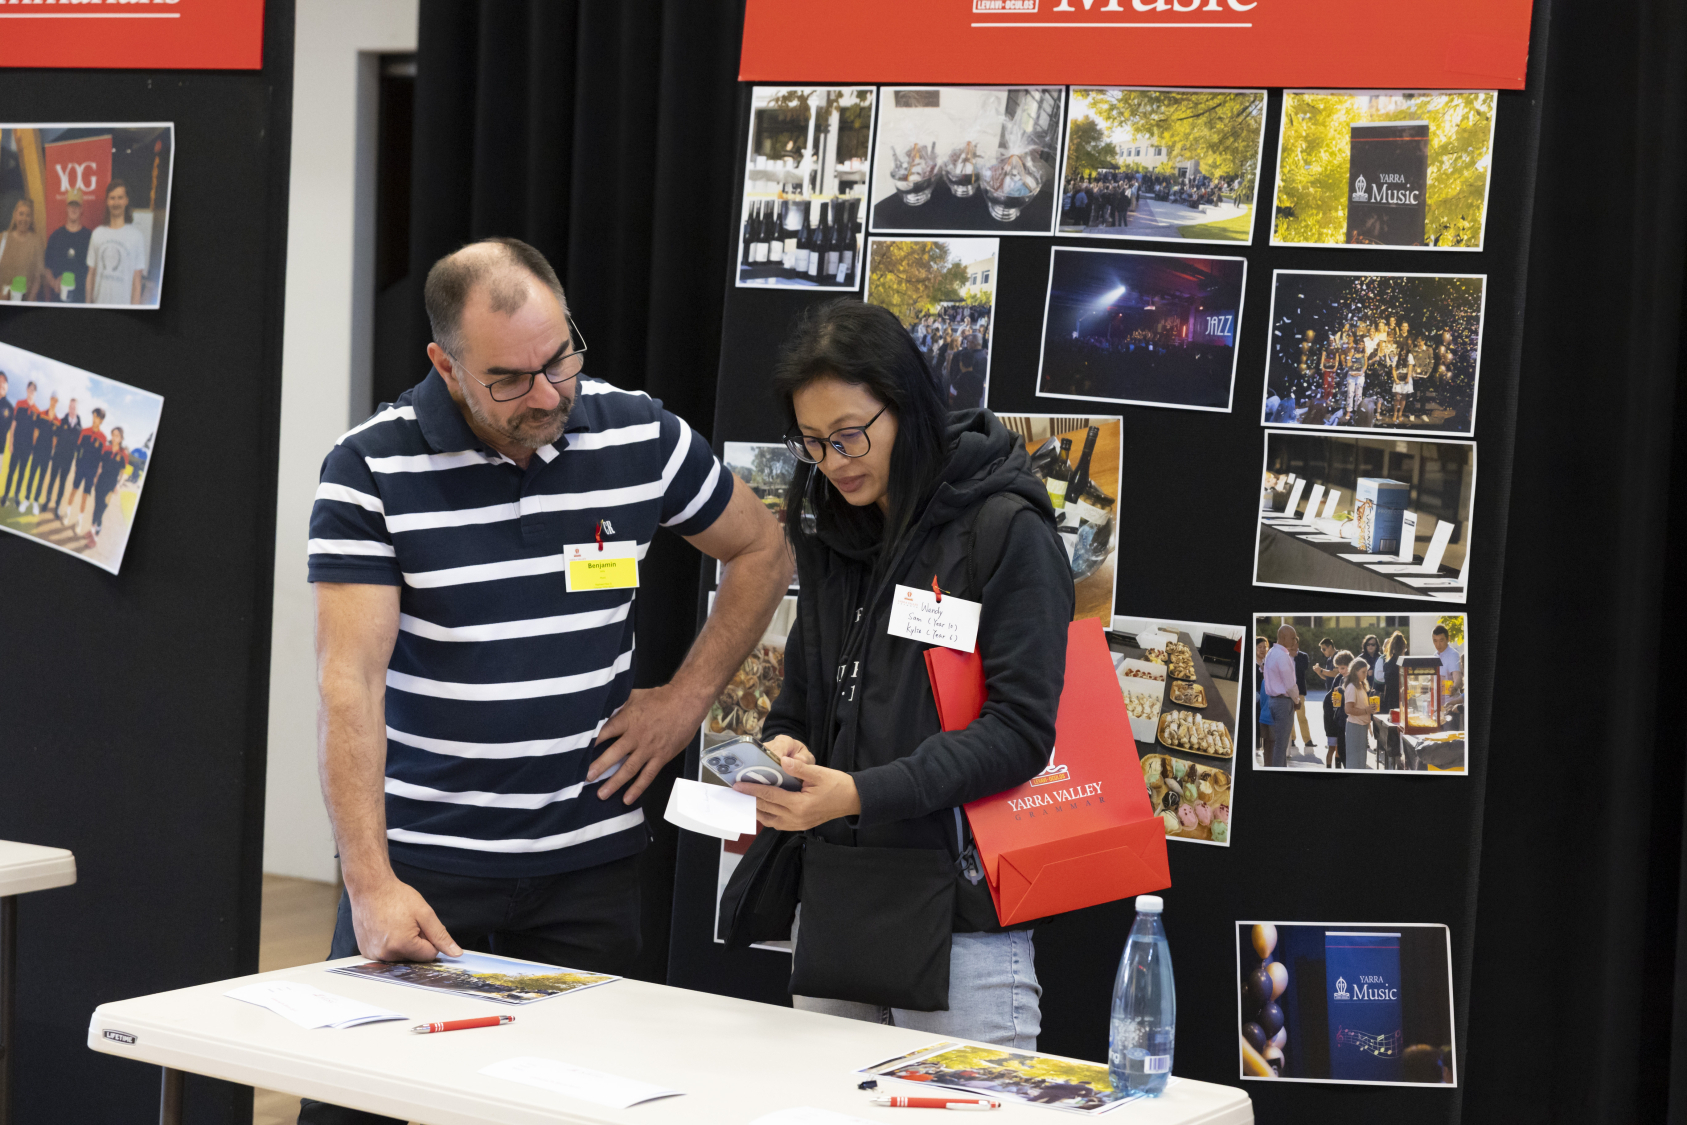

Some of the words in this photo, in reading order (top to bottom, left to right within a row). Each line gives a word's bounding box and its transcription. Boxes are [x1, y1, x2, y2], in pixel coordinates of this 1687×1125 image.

[55, 161, 97, 192] YOG
[1380, 174, 1405, 183] YARRA
[1370, 183, 1419, 205] Music
[1205, 316, 1233, 336] JAZZ
[908, 612, 922, 622] Sam
[906, 622, 922, 636] Kylie
[1007, 793, 1054, 812] YARRA
[1053, 781, 1102, 802] VALLEY
[1015, 797, 1105, 821] GRAMMAR
[1360, 975, 1384, 983] YARRA
[1352, 983, 1398, 1000] Music
[106, 1031, 133, 1043] LIFETIME
